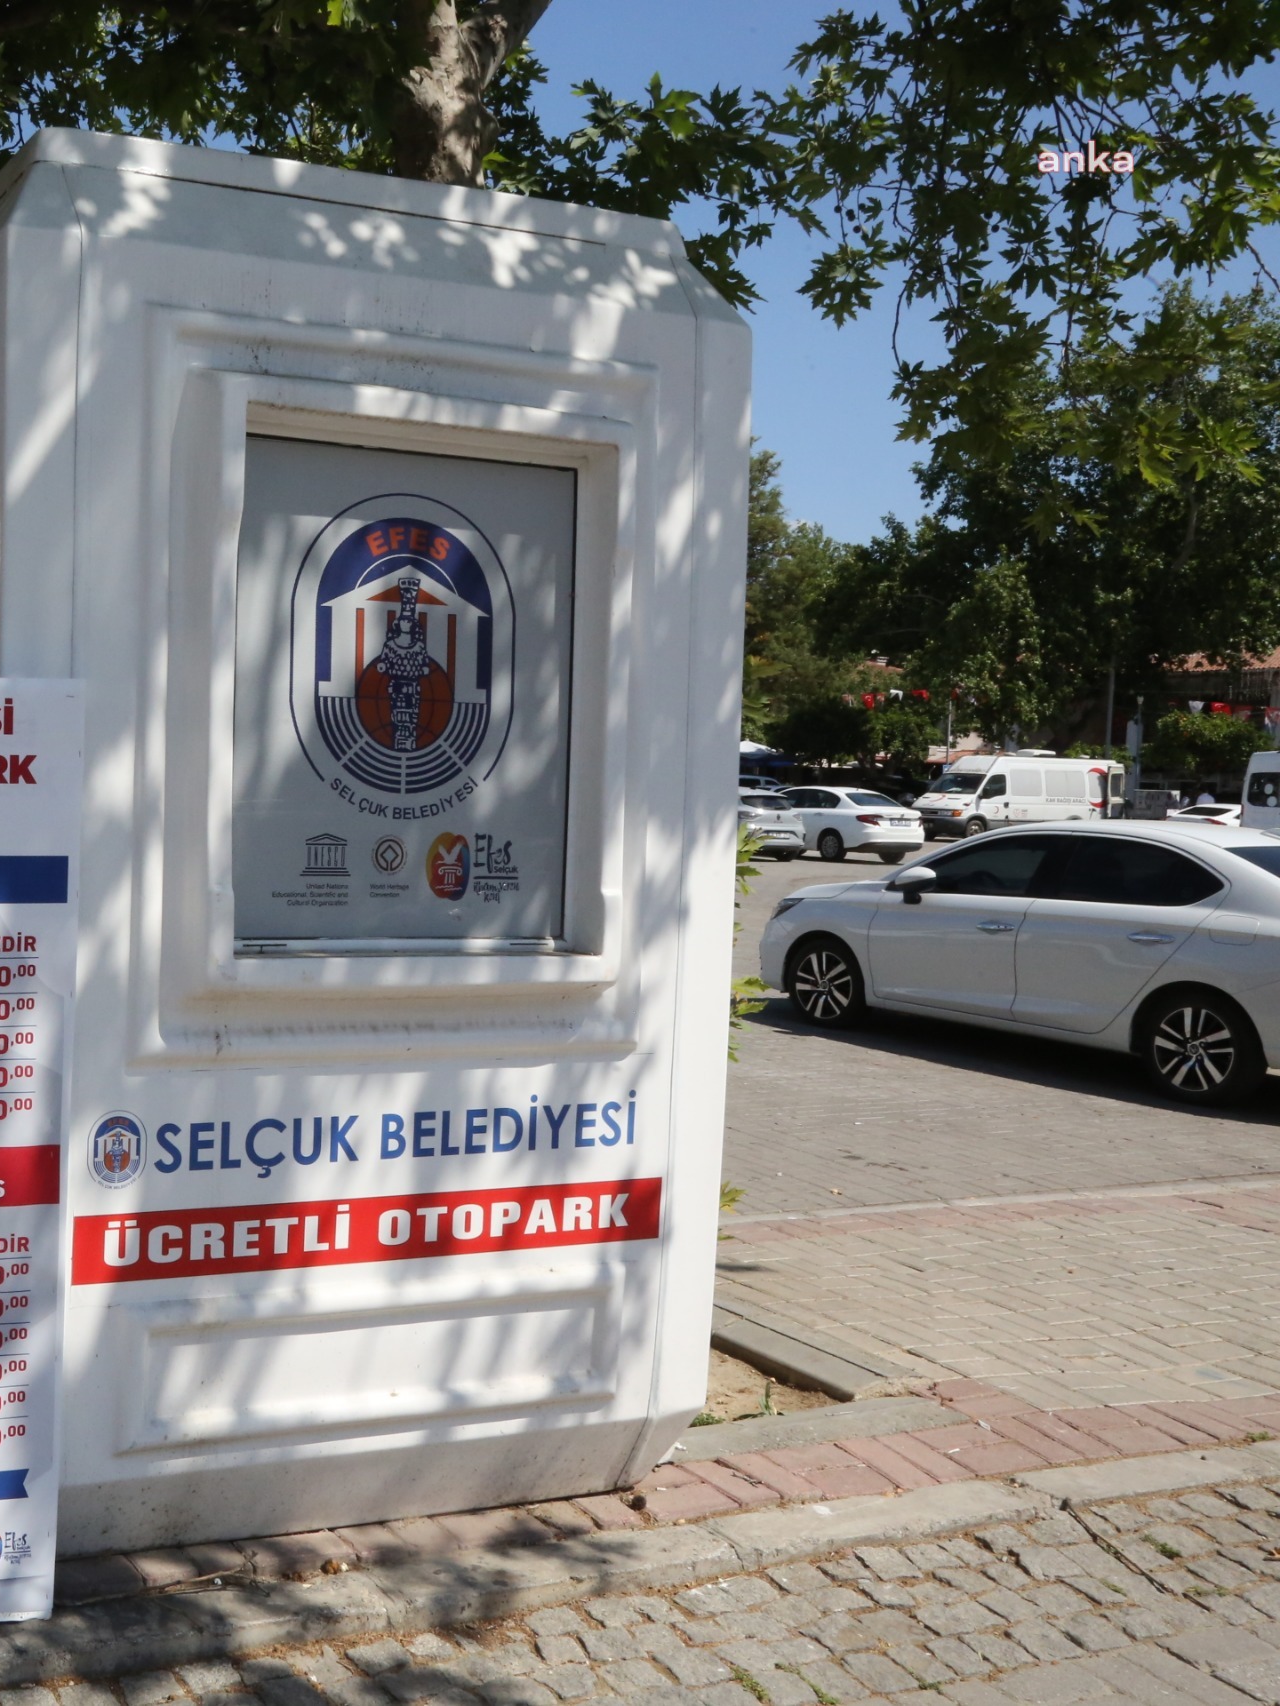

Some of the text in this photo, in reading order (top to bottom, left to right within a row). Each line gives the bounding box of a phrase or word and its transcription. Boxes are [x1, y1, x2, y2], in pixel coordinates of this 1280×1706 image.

[365, 526, 450, 562] EFES
[330, 777, 479, 820] SELÇUK BELEDİYESİ
[154, 1090, 636, 1178] SELÇUK BELEDİYESİ
[104, 1193, 629, 1266] ÜCRETLİ OTOPARK
